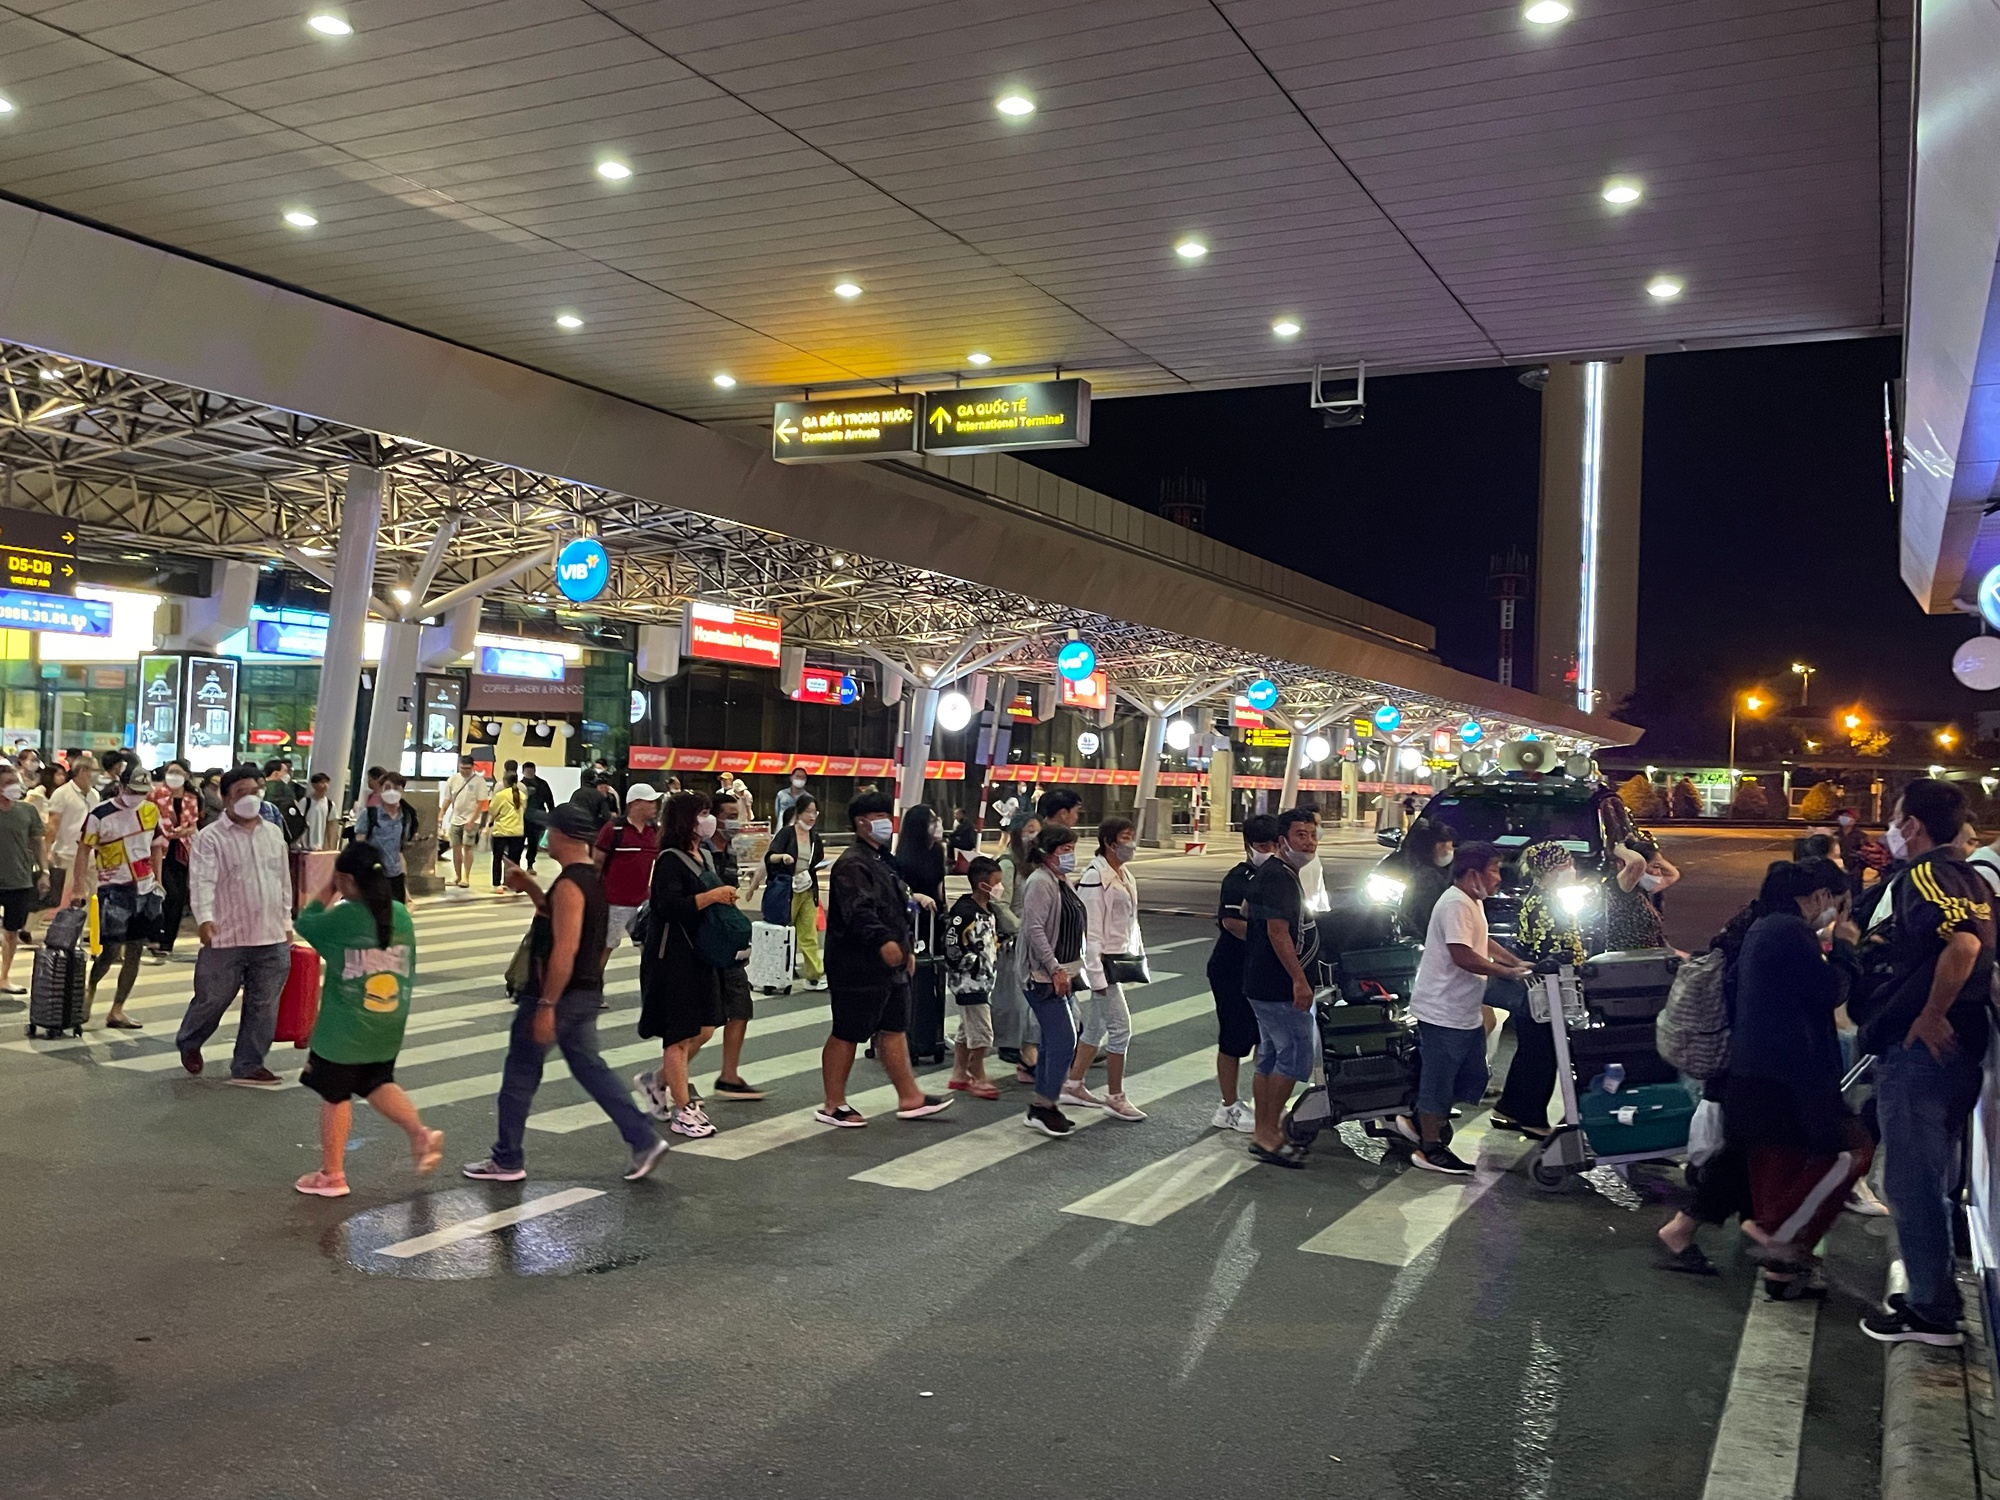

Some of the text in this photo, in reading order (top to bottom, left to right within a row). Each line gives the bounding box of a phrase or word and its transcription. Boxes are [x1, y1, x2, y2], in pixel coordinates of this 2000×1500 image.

[957, 397, 1027, 417] GA QUỐC TẾ
[802, 416, 819, 429] GA
[843, 411, 880, 426] TRONG
[956, 413, 1064, 432] International Terminal
[844, 428, 880, 441] Arrivals
[8, 556, 52, 575] D5-D8
[560, 563, 588, 580] VIB
